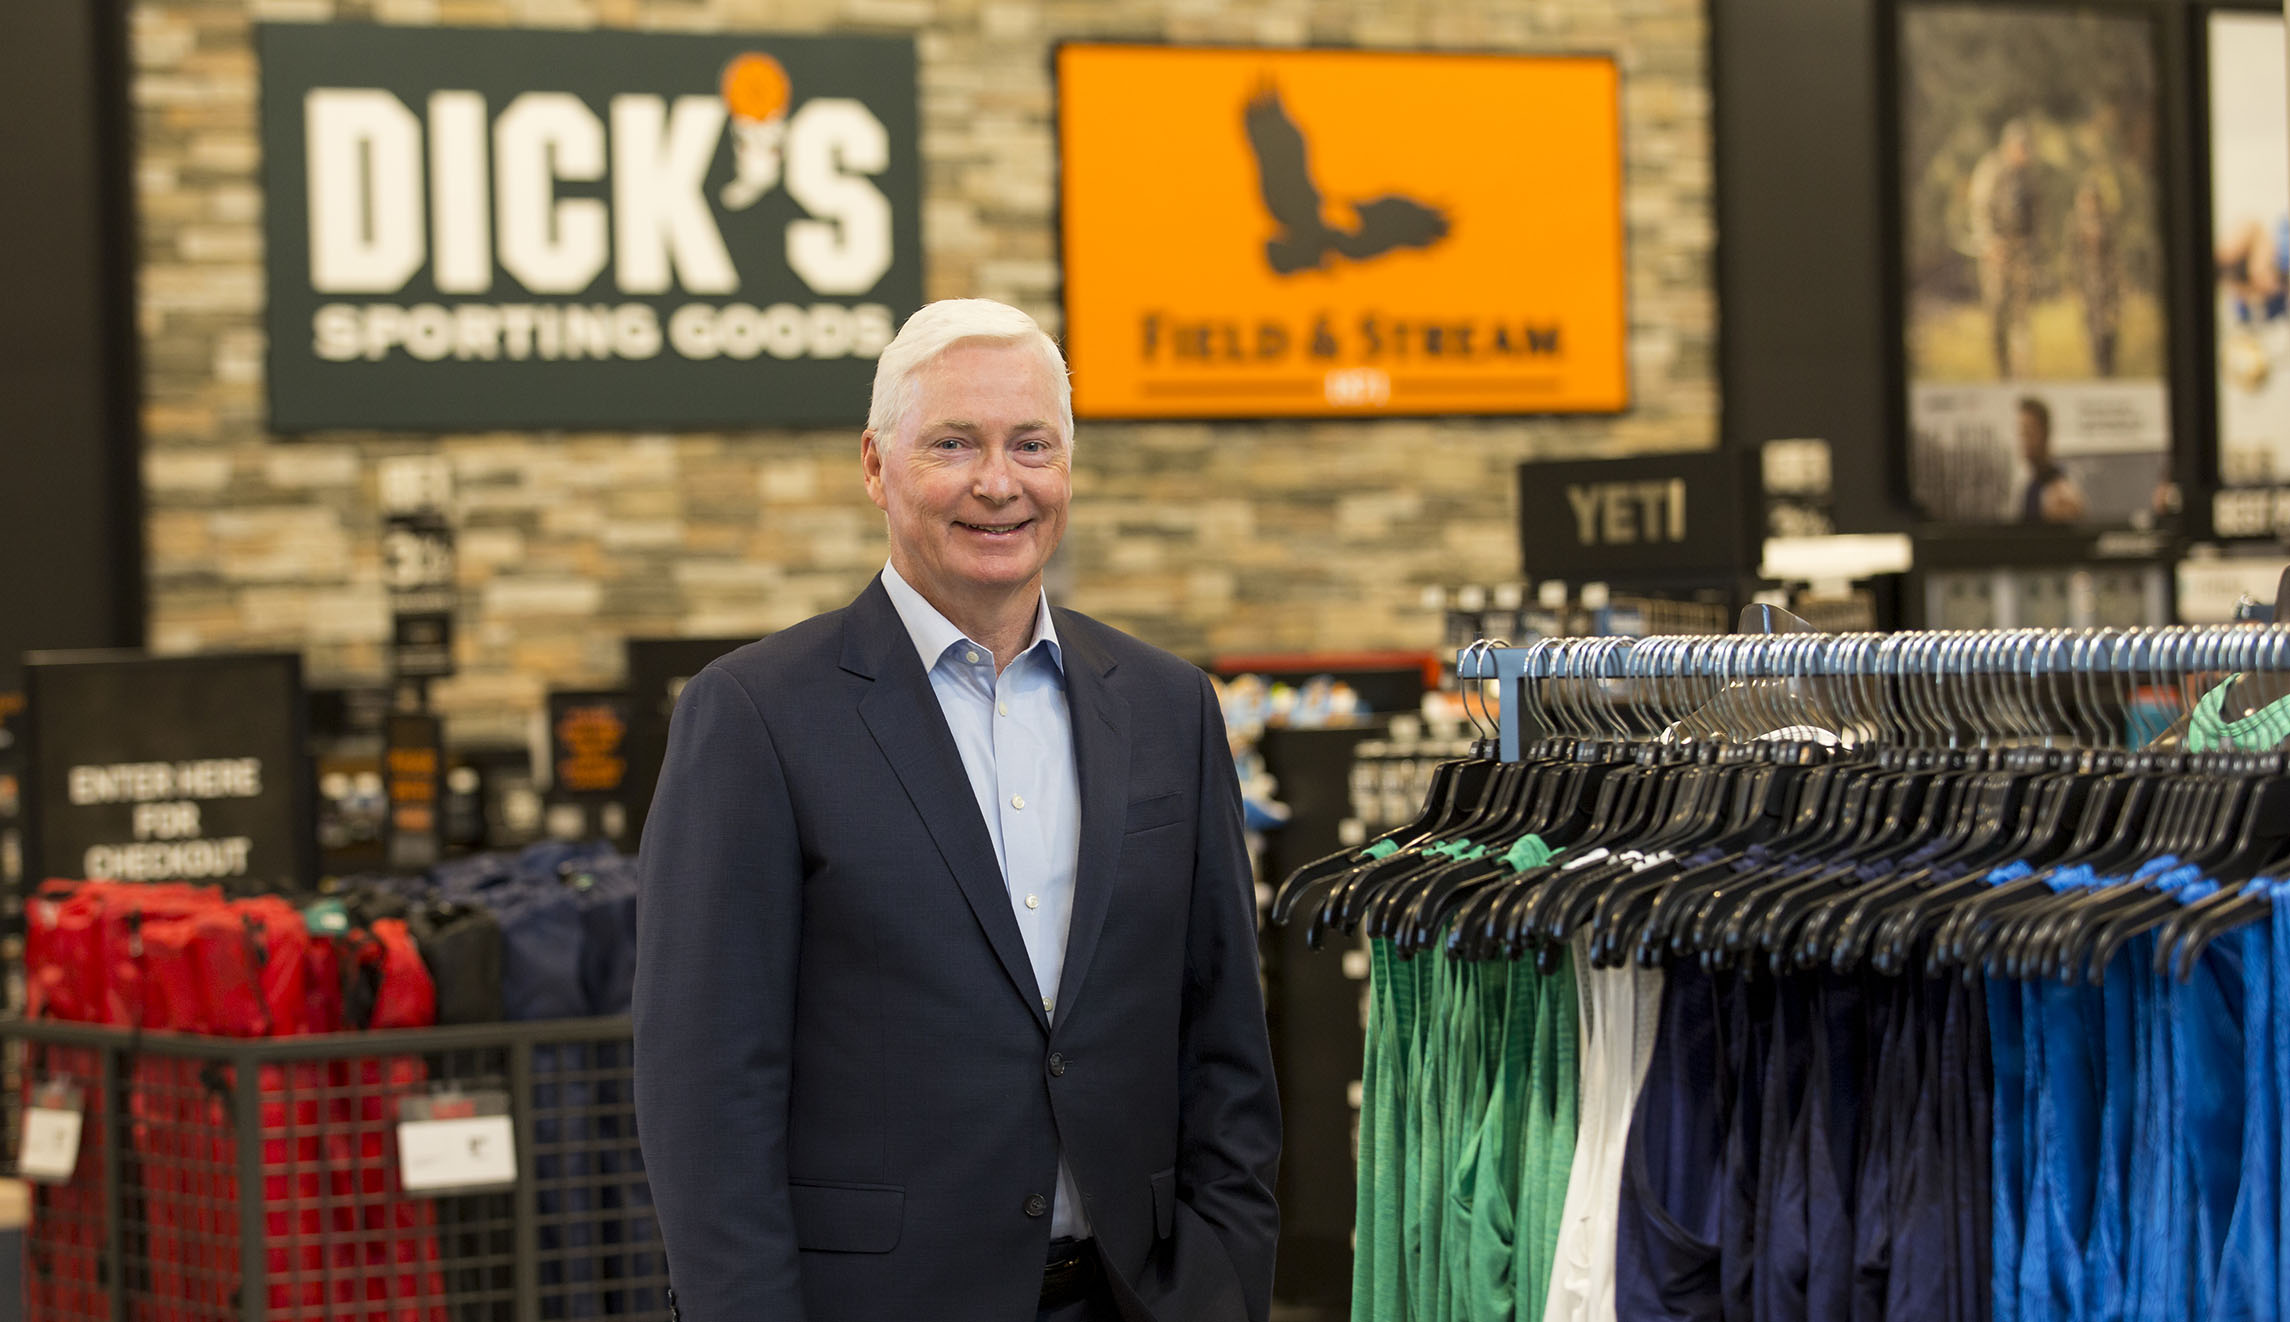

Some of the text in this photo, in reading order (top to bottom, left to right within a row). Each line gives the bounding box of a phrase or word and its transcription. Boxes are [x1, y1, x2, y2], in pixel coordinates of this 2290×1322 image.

[304, 52, 894, 296] DICK'S
[313, 303, 895, 362] SPORTING GOODS
[1140, 308, 1289, 364] FIELD
[1359, 307, 1561, 360] STREAM
[1566, 478, 1686, 544] YETI
[69, 757, 262, 805] ENTER HERE
[133, 801, 200, 840] FOR
[84, 836, 252, 883] CHECKOUT
